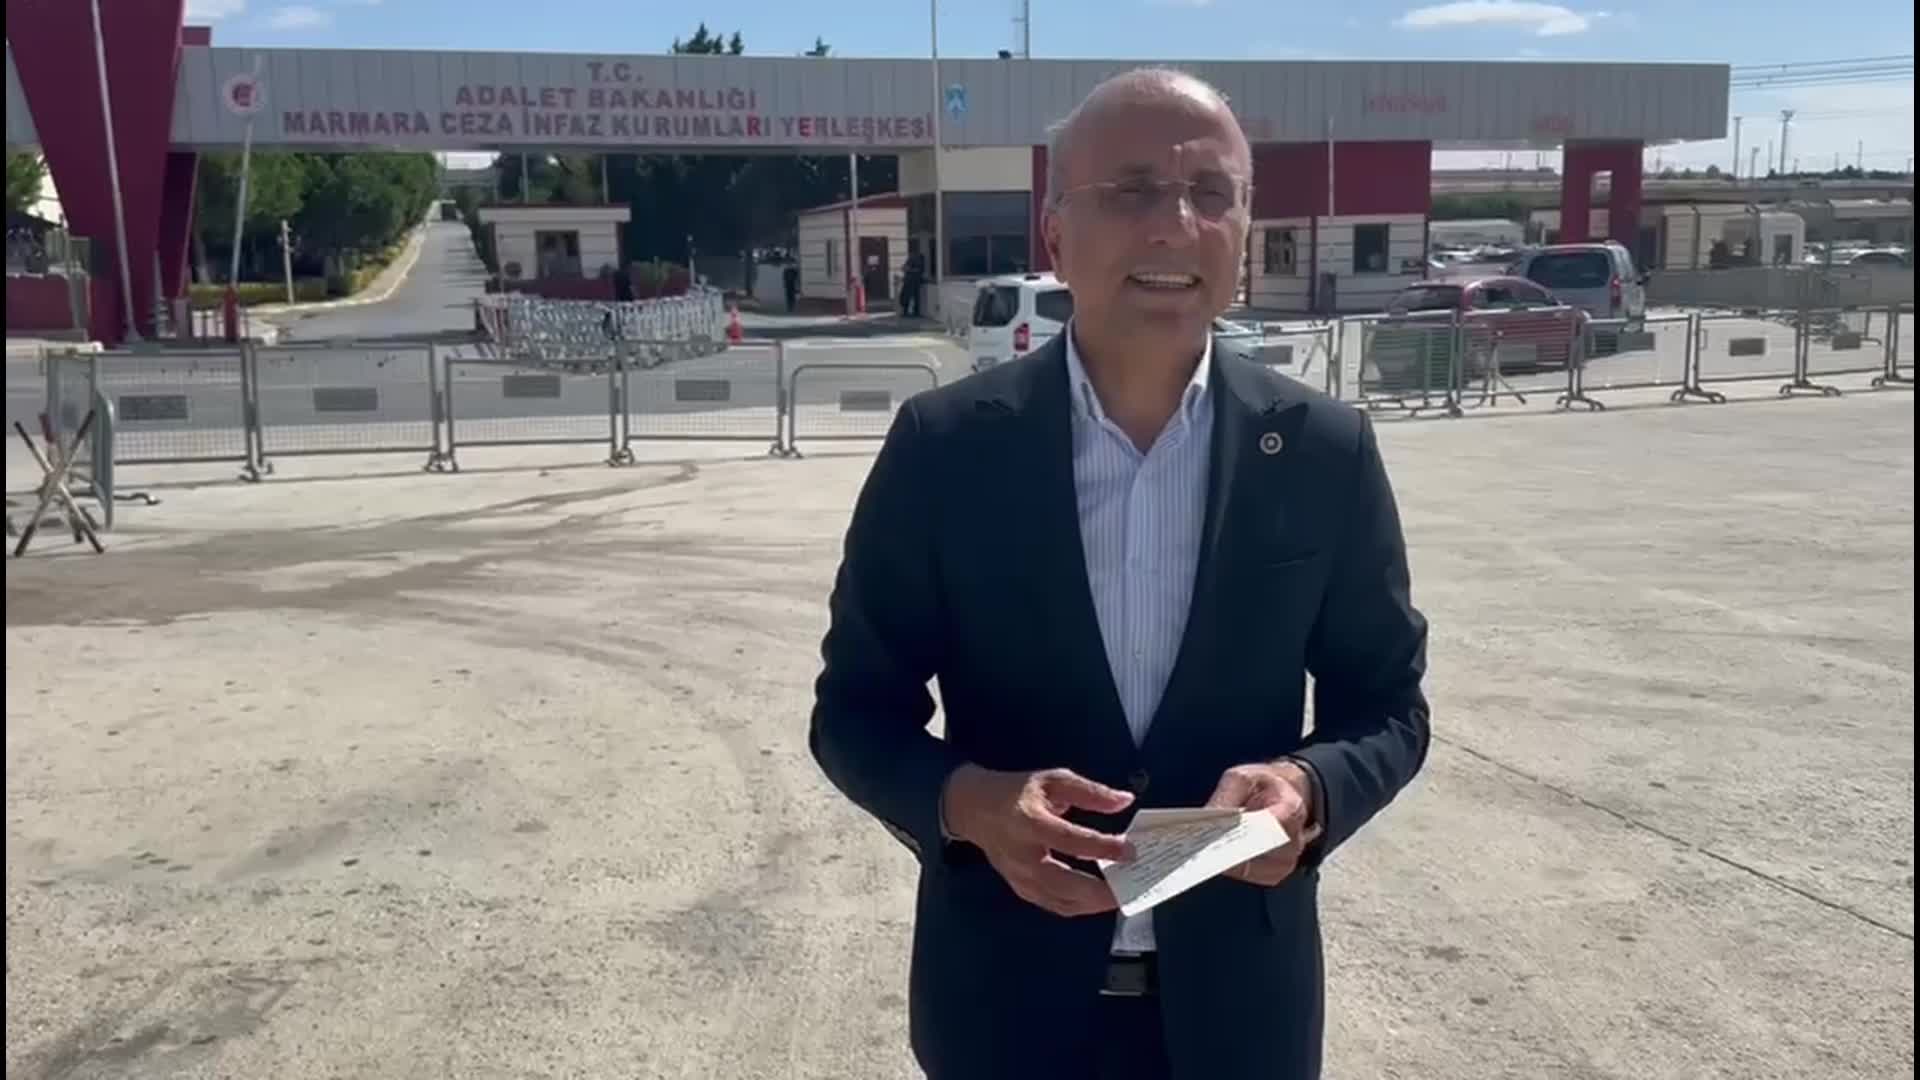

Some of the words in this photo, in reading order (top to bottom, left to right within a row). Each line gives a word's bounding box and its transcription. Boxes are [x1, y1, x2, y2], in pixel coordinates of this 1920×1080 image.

[587, 61, 643, 82] T.C.
[456, 84, 576, 107] ADALET
[587, 86, 757, 110] BAKANLIĞI
[283, 110, 431, 135] MARMARA
[441, 112, 512, 135] CEZA
[523, 107, 604, 136] İNFAZ
[612, 115, 771, 137] KURUMLARI
[779, 113, 934, 142] YERLEŞKESİ
